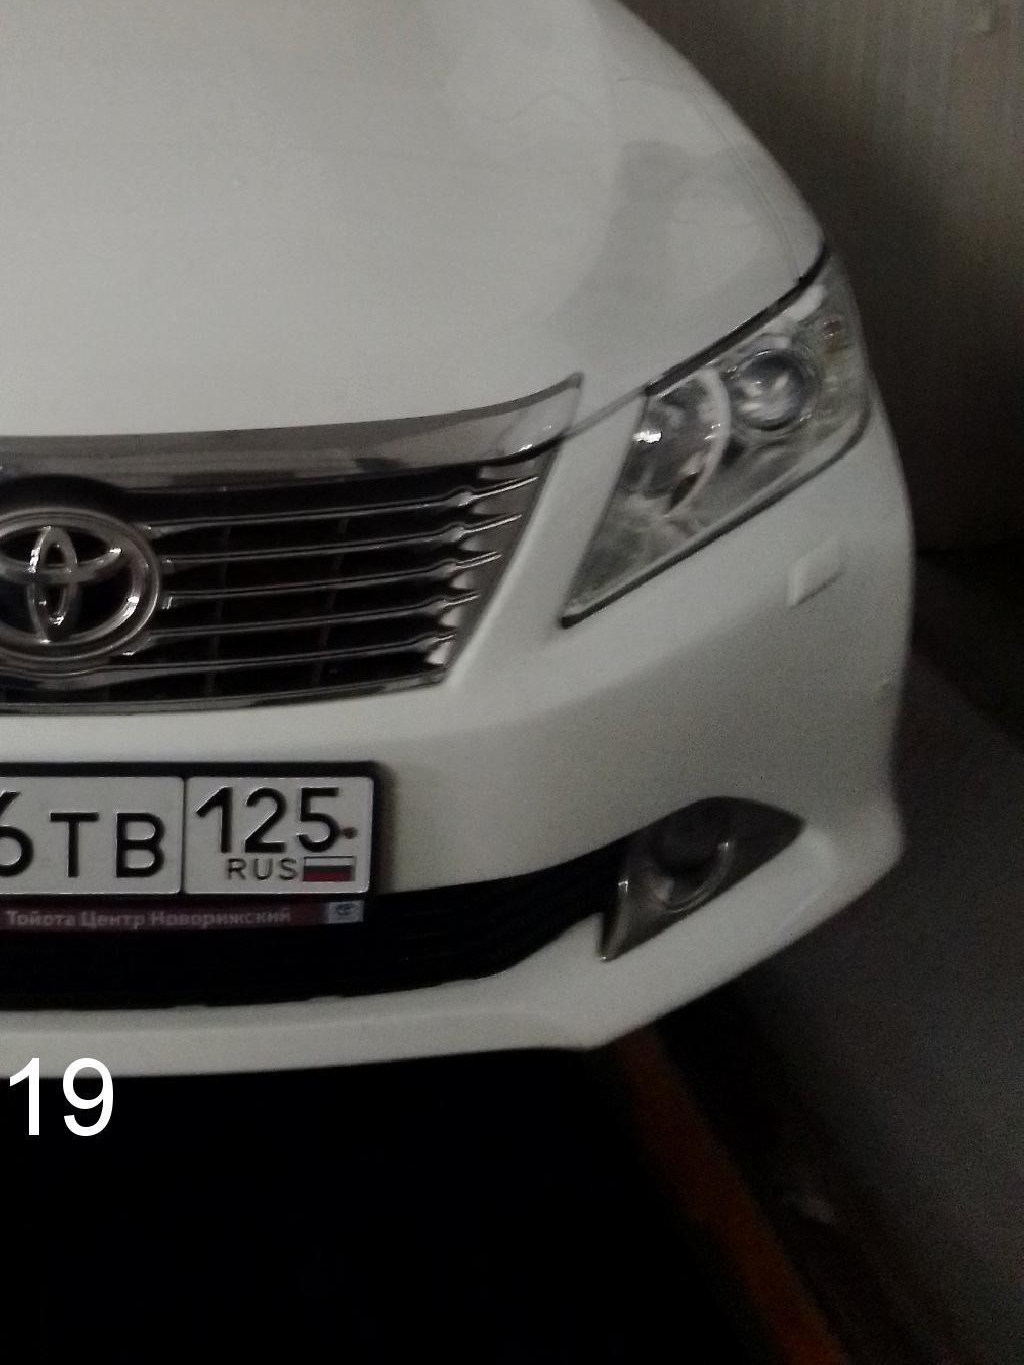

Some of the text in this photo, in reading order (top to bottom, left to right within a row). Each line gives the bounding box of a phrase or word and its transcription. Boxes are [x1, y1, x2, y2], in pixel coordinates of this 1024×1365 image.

[195, 786, 341, 854] 125
[226, 856, 298, 882] RUS
[5, 910, 75, 927] Тойота
[80, 910, 144, 929] Центр
[149, 907, 292, 927] Новорижский
